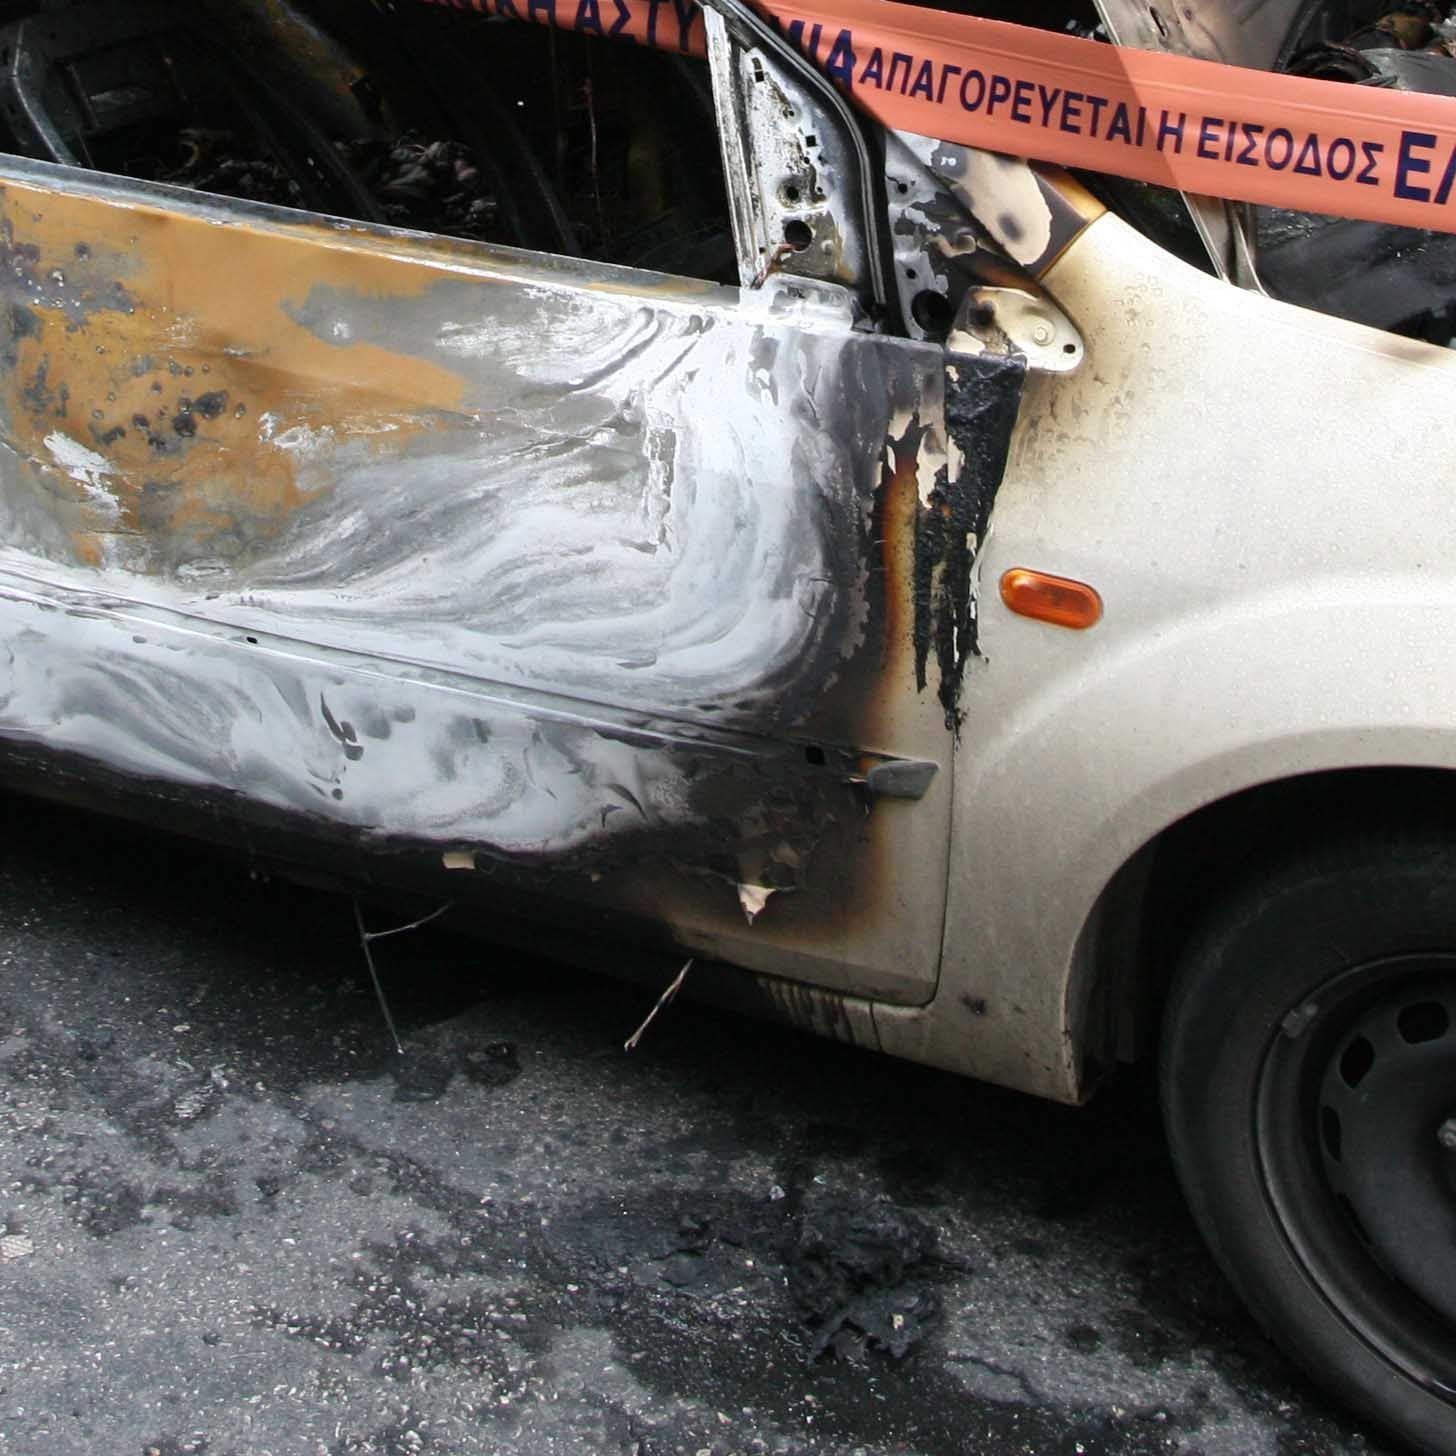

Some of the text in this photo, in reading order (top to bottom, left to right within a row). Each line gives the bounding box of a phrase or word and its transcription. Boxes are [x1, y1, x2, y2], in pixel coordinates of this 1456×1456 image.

[858, 47, 1147, 146] ΑΠΑΓΟΡΕΥΕΤΑΙ
[1156, 111, 1185, 154] Η
[1196, 117, 1385, 186] ΕΙΣΟΔΟΣ
